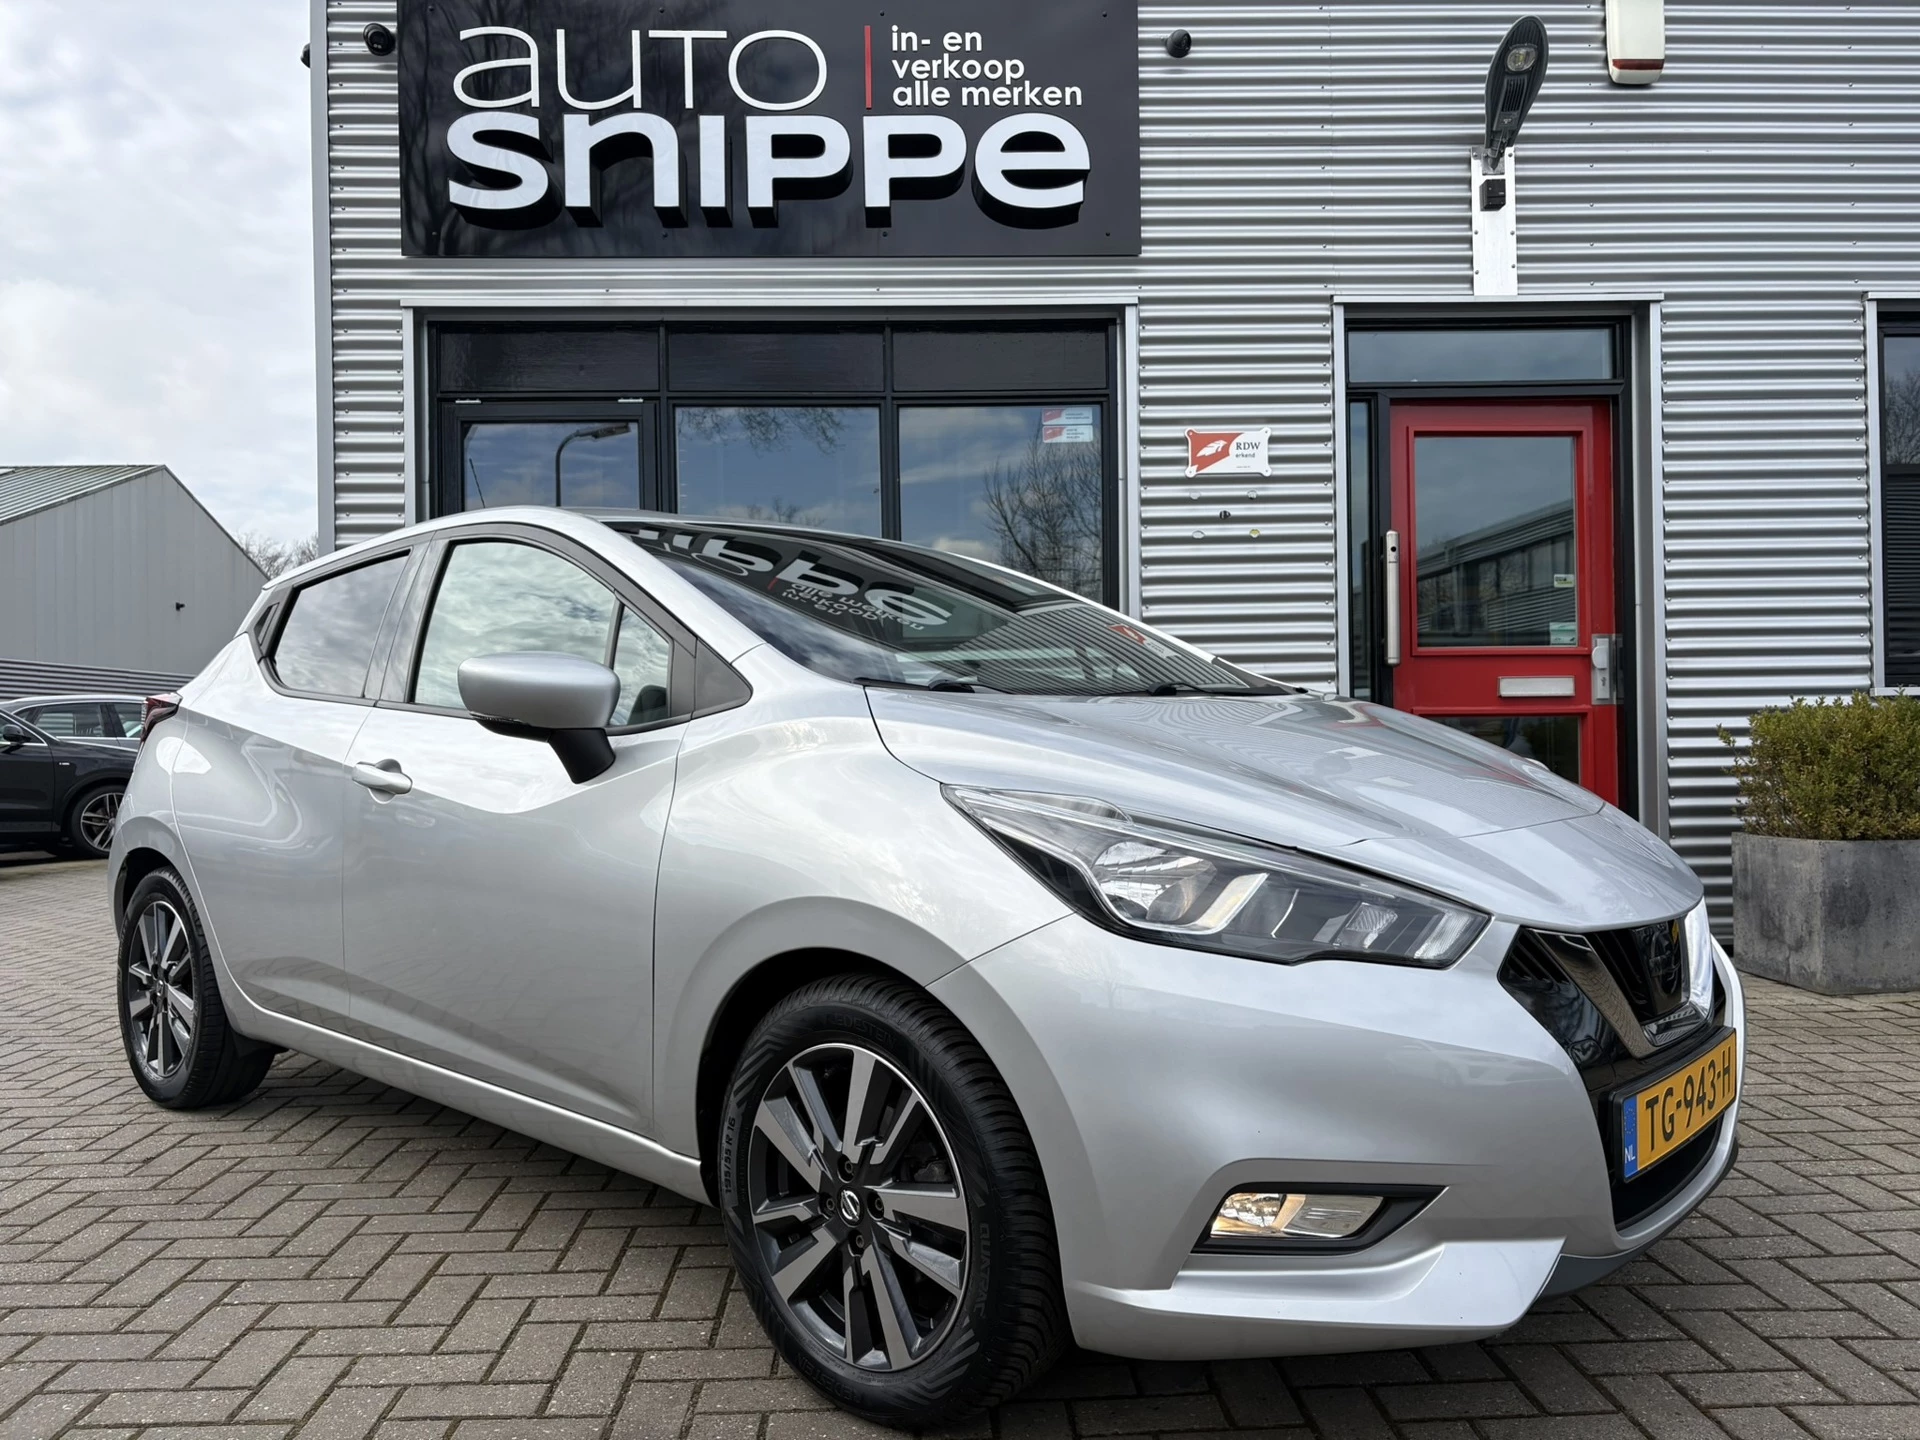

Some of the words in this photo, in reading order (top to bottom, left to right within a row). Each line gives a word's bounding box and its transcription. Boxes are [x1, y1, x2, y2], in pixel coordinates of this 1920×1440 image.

[891, 24, 931, 51] in-
[943, 31, 983, 52] en
[891, 53, 1025, 85] verkoop
[893, 80, 950, 106] alle
[962, 80, 1082, 106] merken
[1235, 442, 1260, 451] RDW
[1646, 1046, 1730, 1152] TG-943-H
[727, 1116, 736, 1132] 16
[1624, 1145, 1635, 1163] NL
